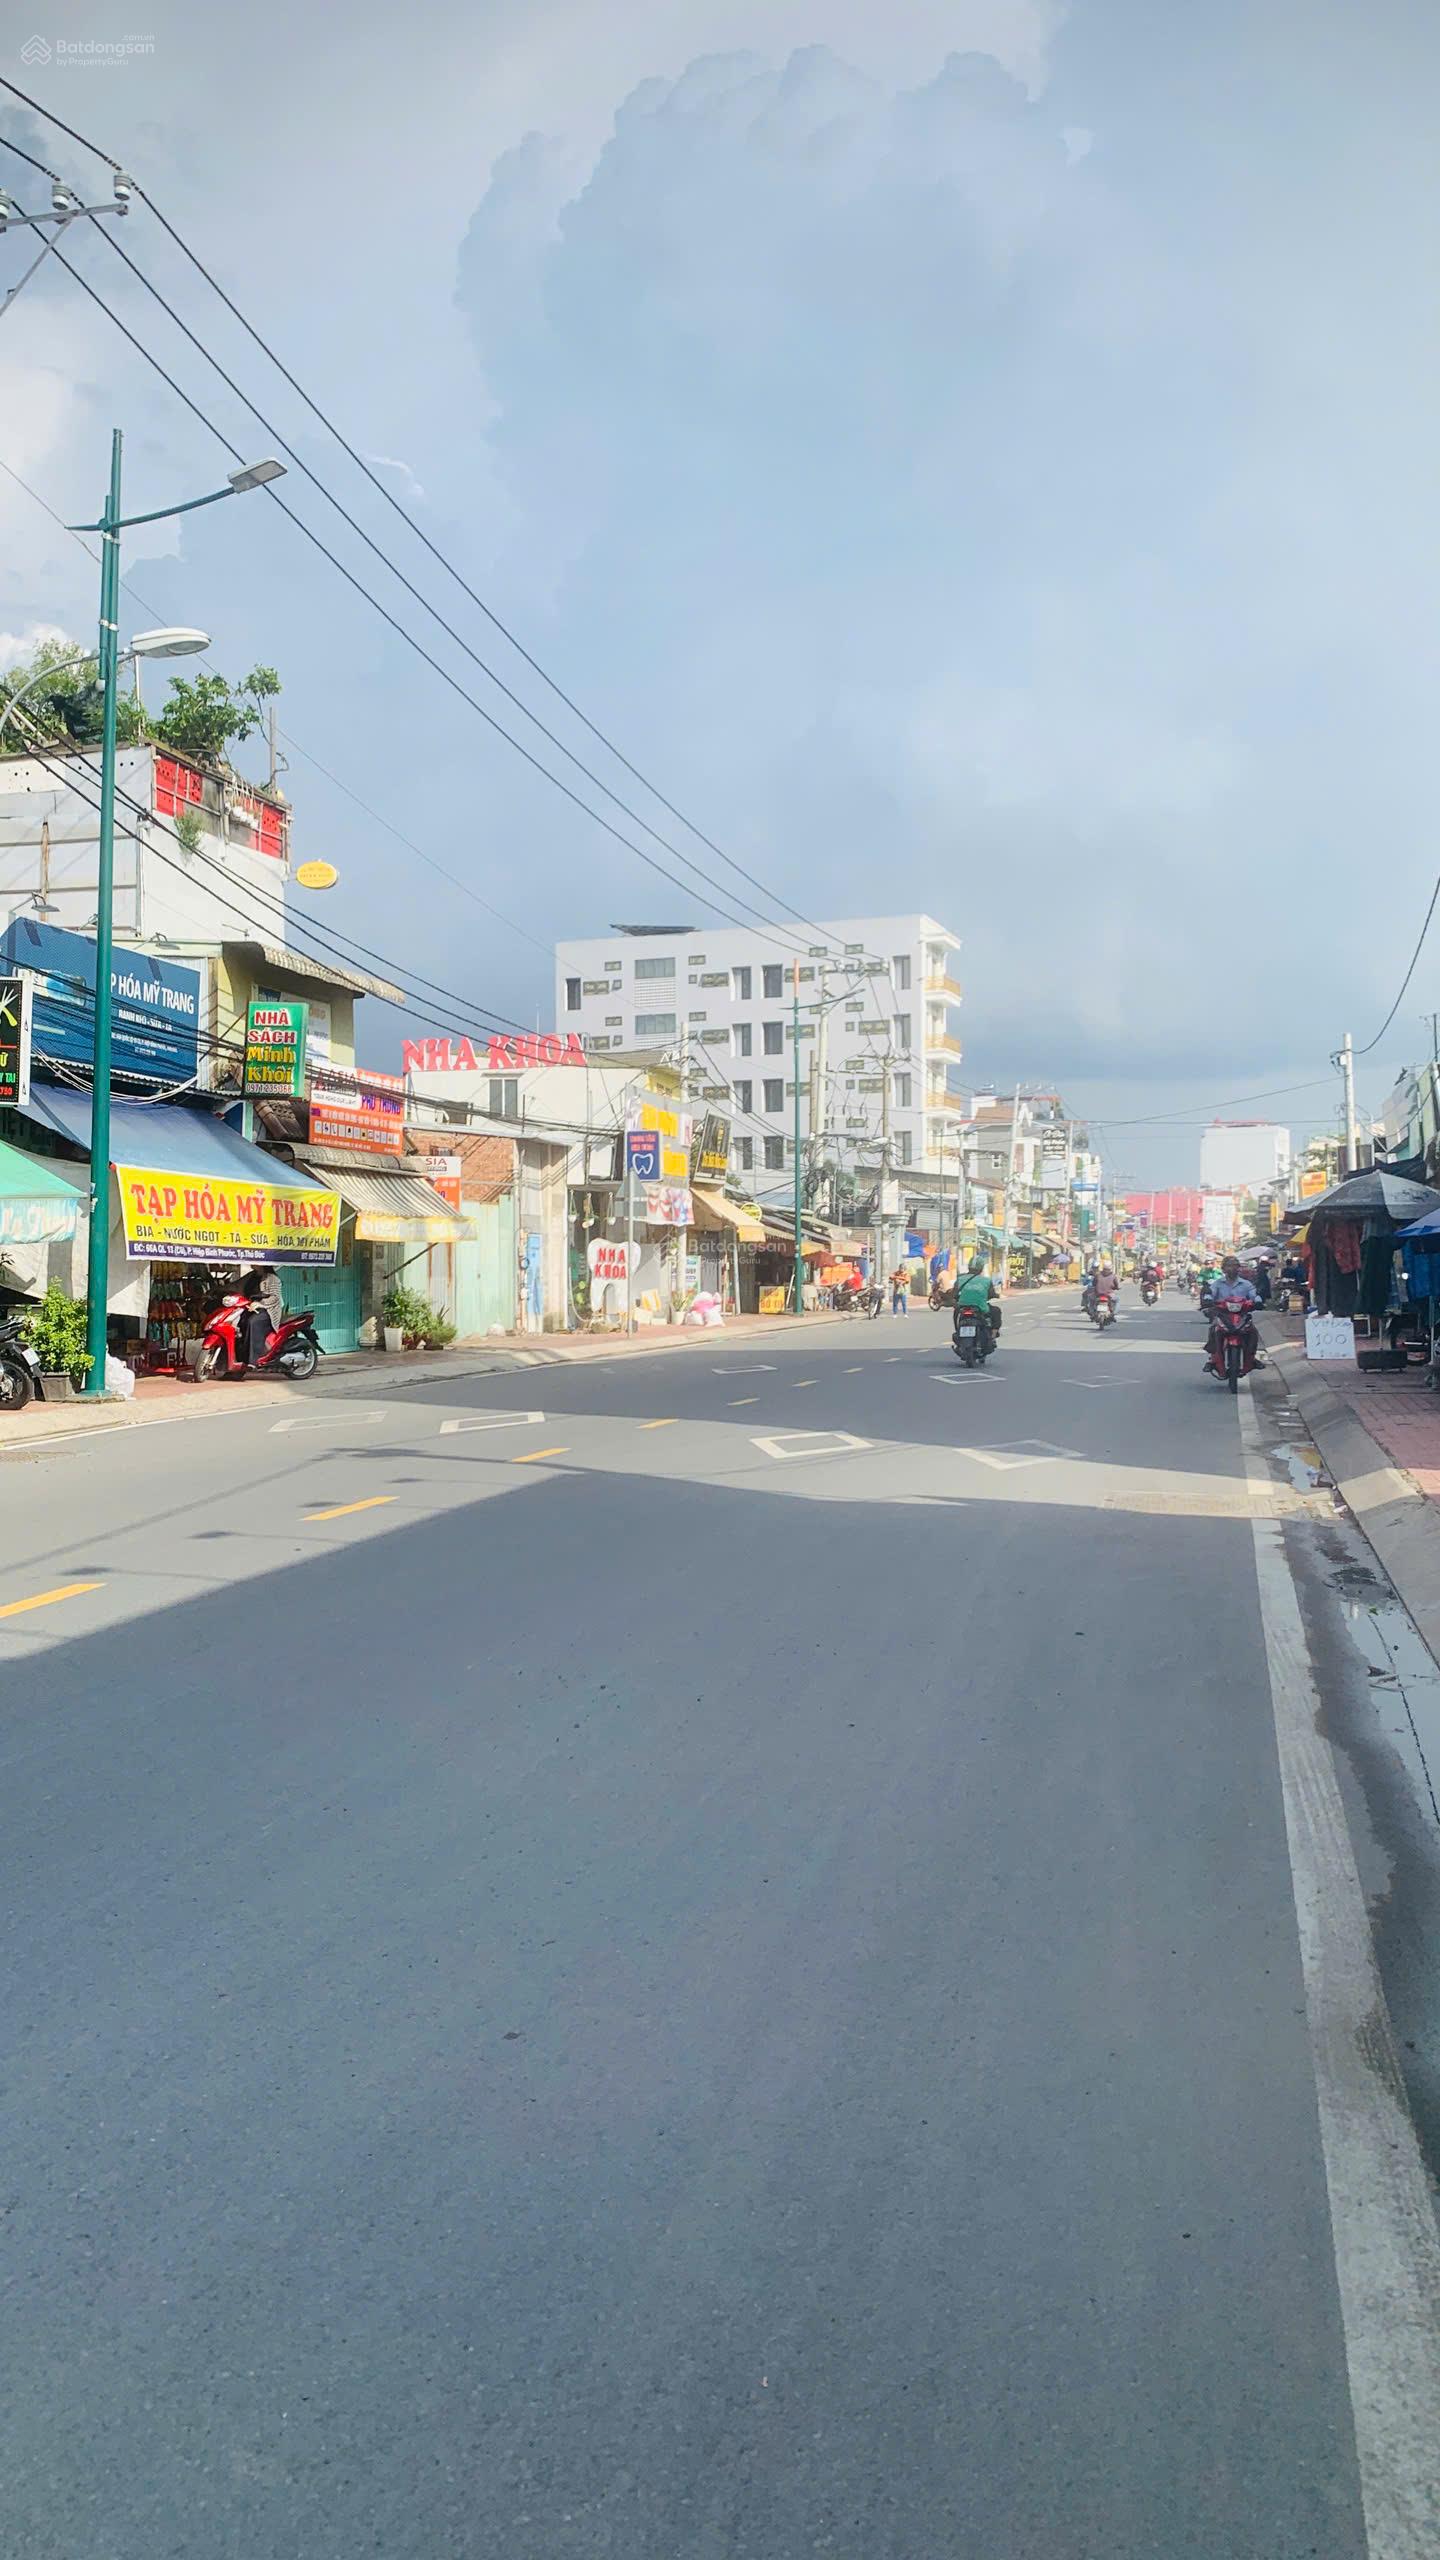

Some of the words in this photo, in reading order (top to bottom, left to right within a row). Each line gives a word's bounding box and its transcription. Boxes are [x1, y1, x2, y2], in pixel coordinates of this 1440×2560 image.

[118, 973, 141, 1000] HÓA
[143, 980, 160, 1005] MỸ
[161, 987, 195, 1014] TRANG
[255, 1008, 290, 1025] NHÀ
[248, 1027, 296, 1043] SÁCH
[246, 1045, 295, 1062] Minh
[401, 1037, 479, 1072] NHA
[488, 1032, 588, 1069] KHOA
[247, 1065, 293, 1083] Khôi
[130, 1183, 177, 1224] TẠP
[183, 1183, 231, 1222] HÓA
[236, 1189, 266, 1224] MỸ
[271, 1198, 333, 1229] TRANG
[136, 1225, 154, 1238] BIA
[163, 1226, 191, 1241] NƯỚC
[194, 1230, 220, 1244] NGỌT
[598, 1247, 626, 1263] NHA
[594, 1263, 626, 1280] KHOA
